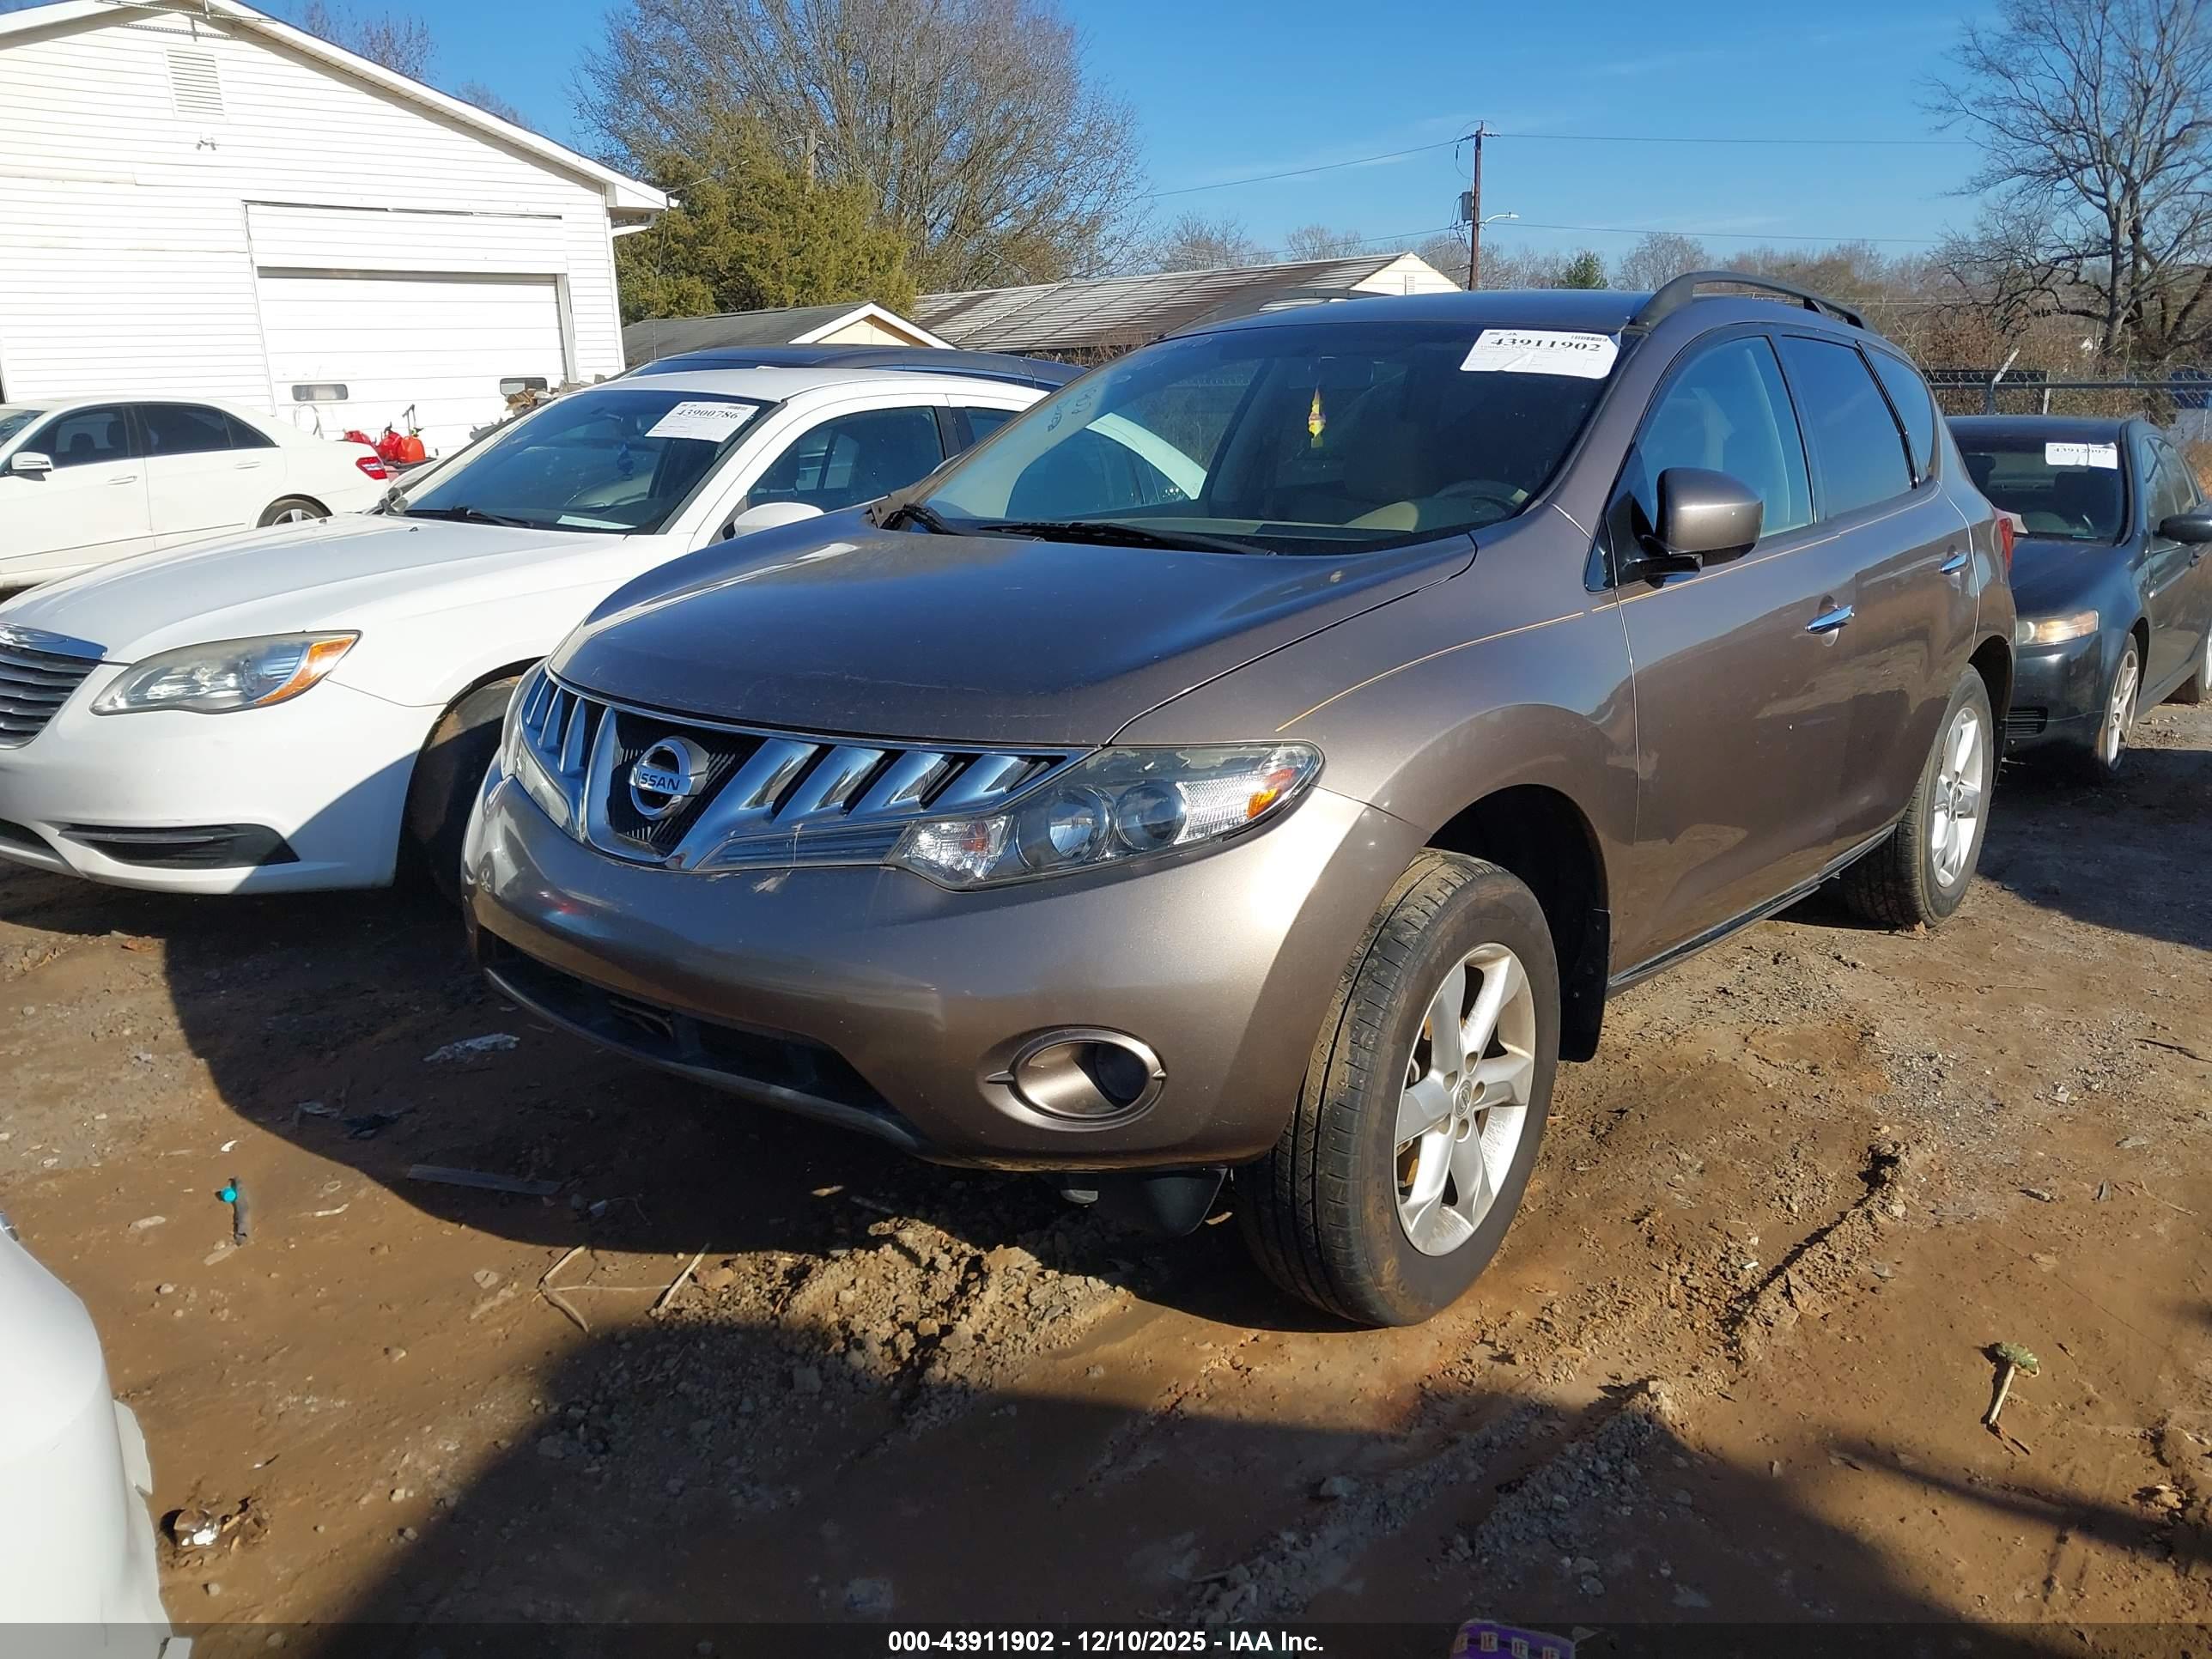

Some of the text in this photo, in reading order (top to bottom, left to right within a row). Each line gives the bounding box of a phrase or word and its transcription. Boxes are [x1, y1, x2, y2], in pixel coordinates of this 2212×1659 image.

[1490, 337, 1602, 352] 43911902
[676, 409, 739, 419] 43900786
[632, 766, 681, 791] NISSAN
